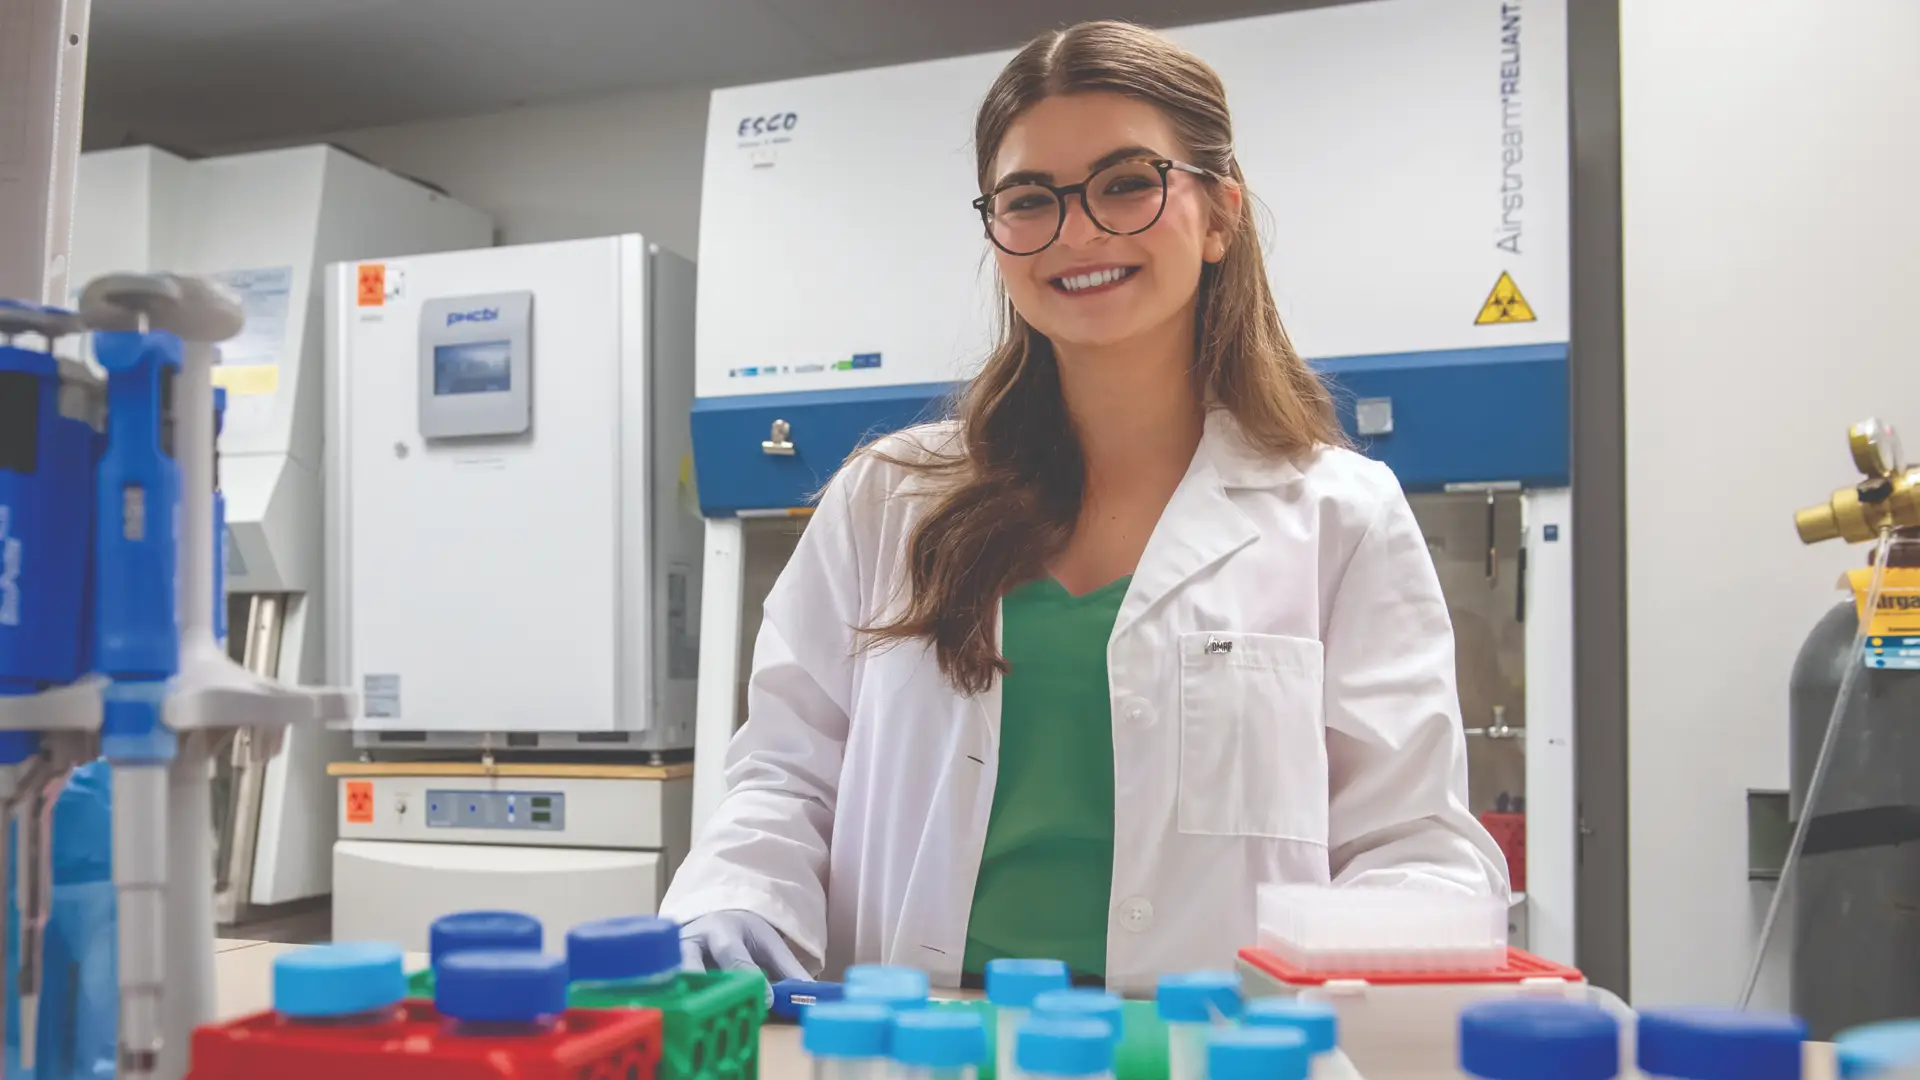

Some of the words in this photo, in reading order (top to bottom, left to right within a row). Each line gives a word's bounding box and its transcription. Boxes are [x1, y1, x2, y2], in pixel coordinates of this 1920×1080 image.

[1500, 3, 1521, 95] RELIANT
[738, 112, 798, 137] ESCO
[1495, 102, 1523, 255] Airstream
